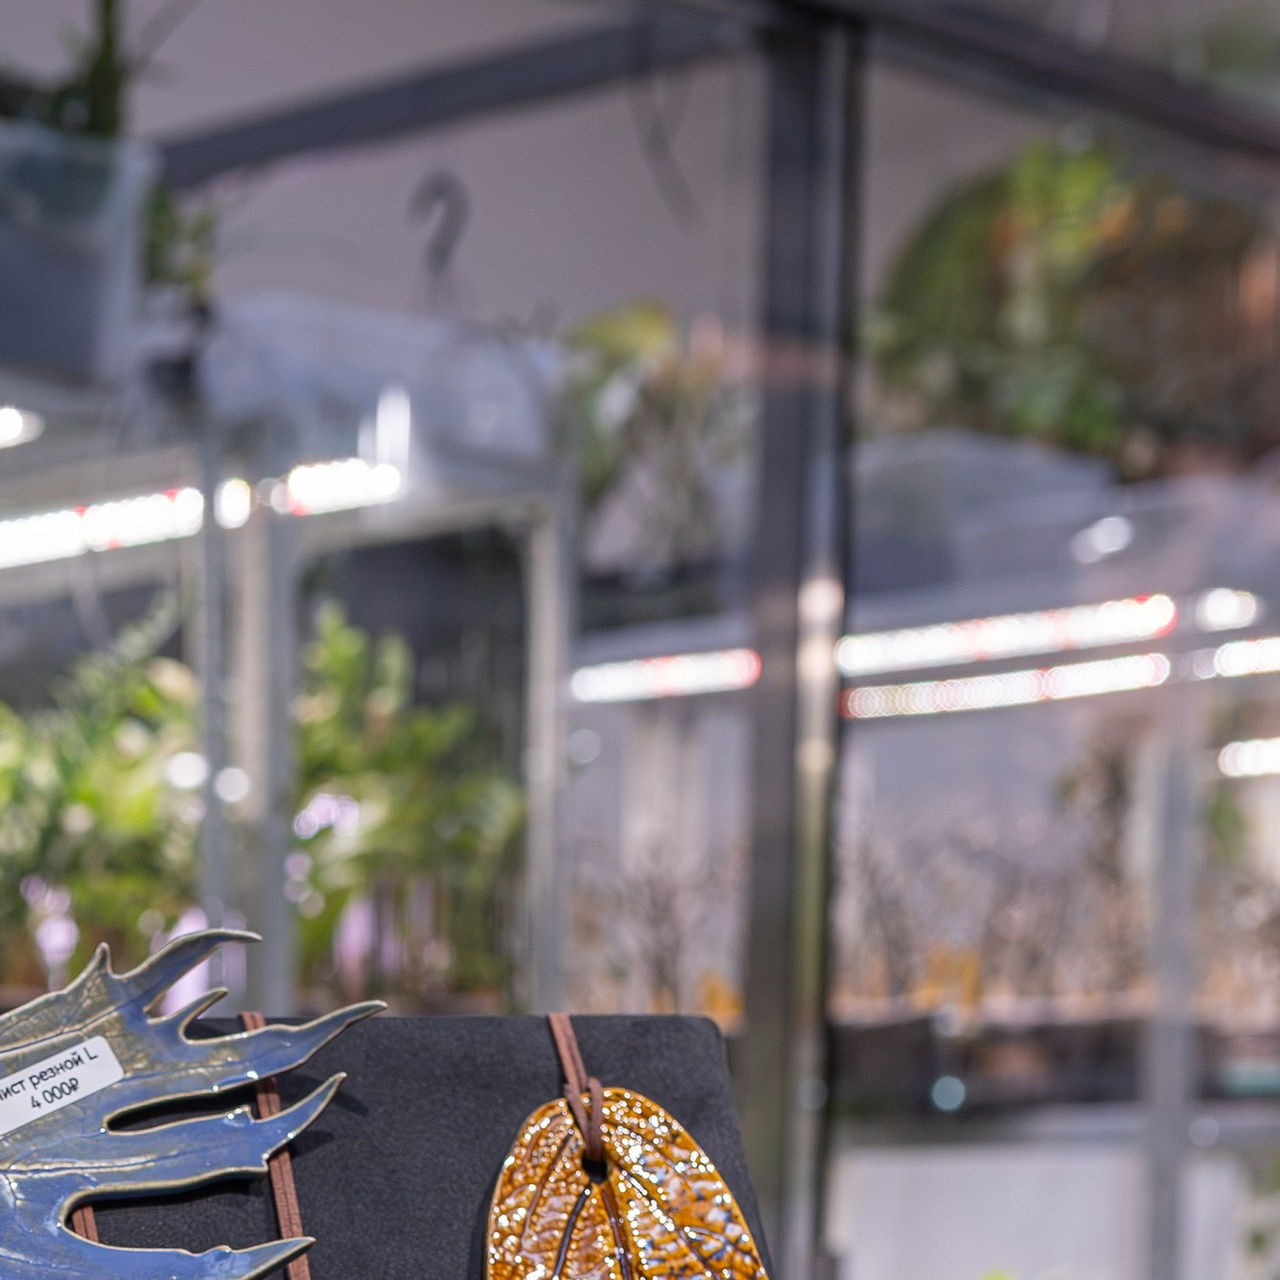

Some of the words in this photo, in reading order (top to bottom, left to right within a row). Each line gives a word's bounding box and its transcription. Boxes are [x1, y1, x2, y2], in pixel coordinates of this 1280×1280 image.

[28, 1052, 84, 1089] резной
[84, 1047, 98, 1061] L
[31, 1096, 42, 1109] 4
